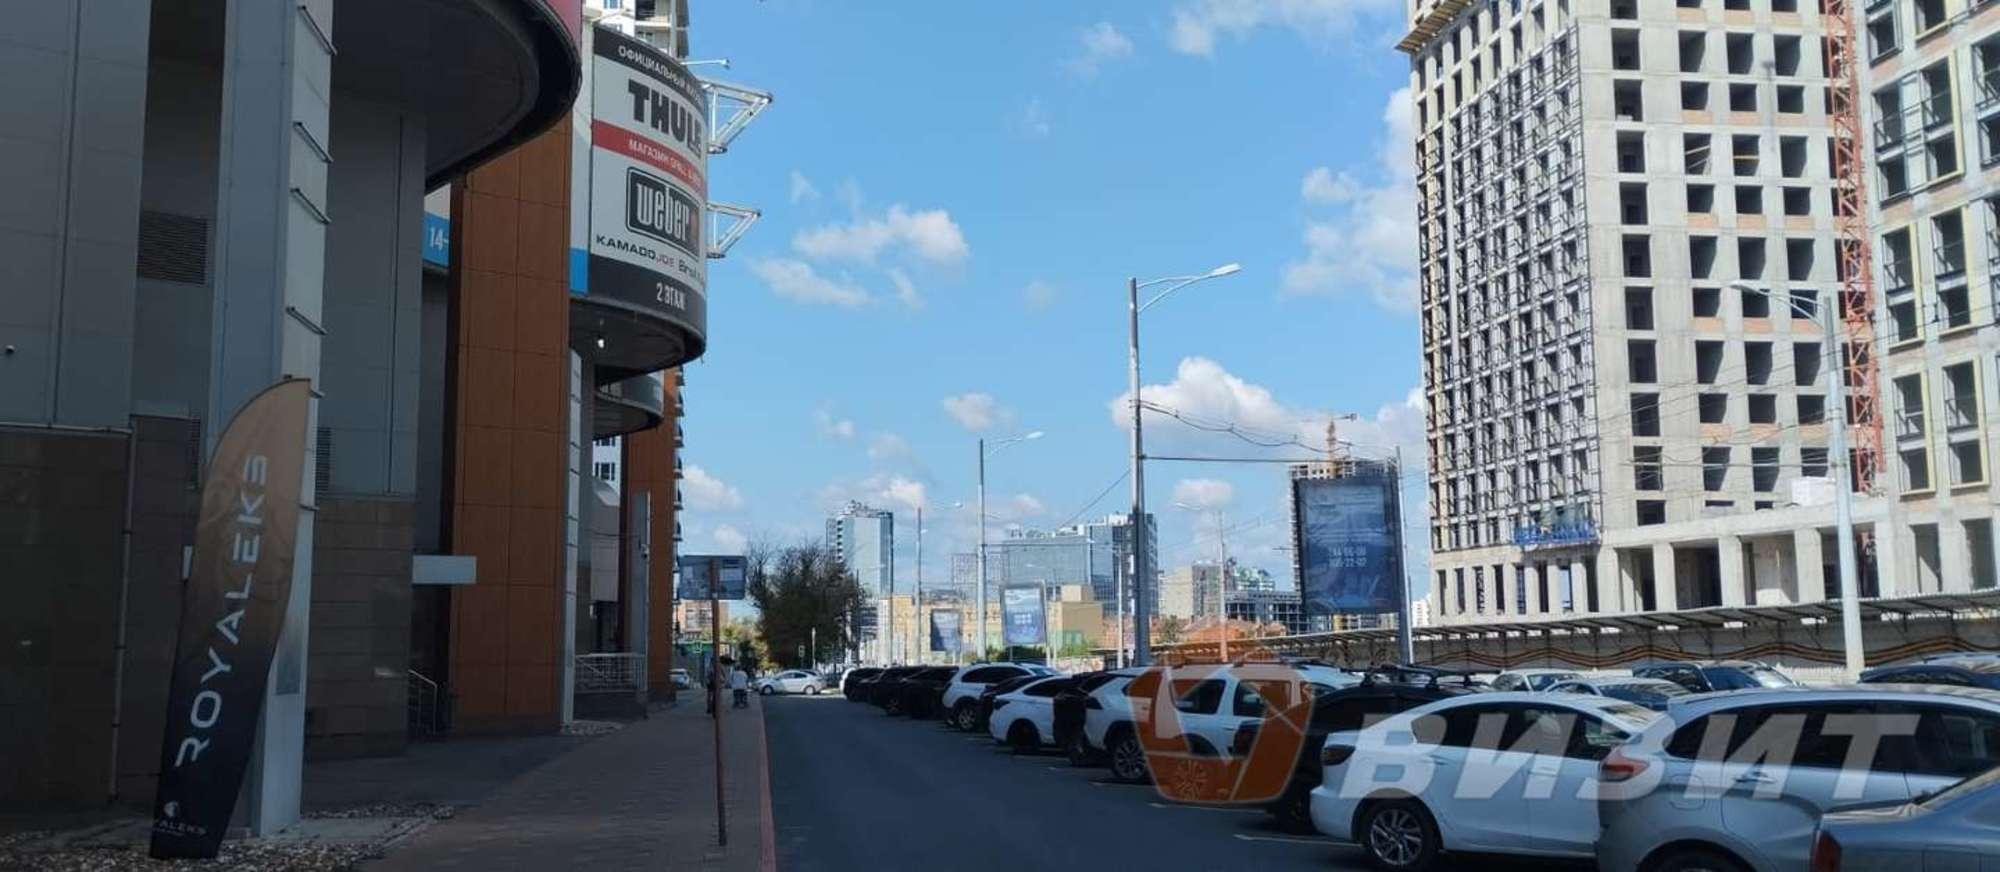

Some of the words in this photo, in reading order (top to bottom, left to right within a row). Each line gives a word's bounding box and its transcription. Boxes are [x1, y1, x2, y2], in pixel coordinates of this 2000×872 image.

[656, 281, 663, 301] 2
[665, 286, 686, 310] ЭТАЖ
[175, 454, 267, 767] ROYALEKS
